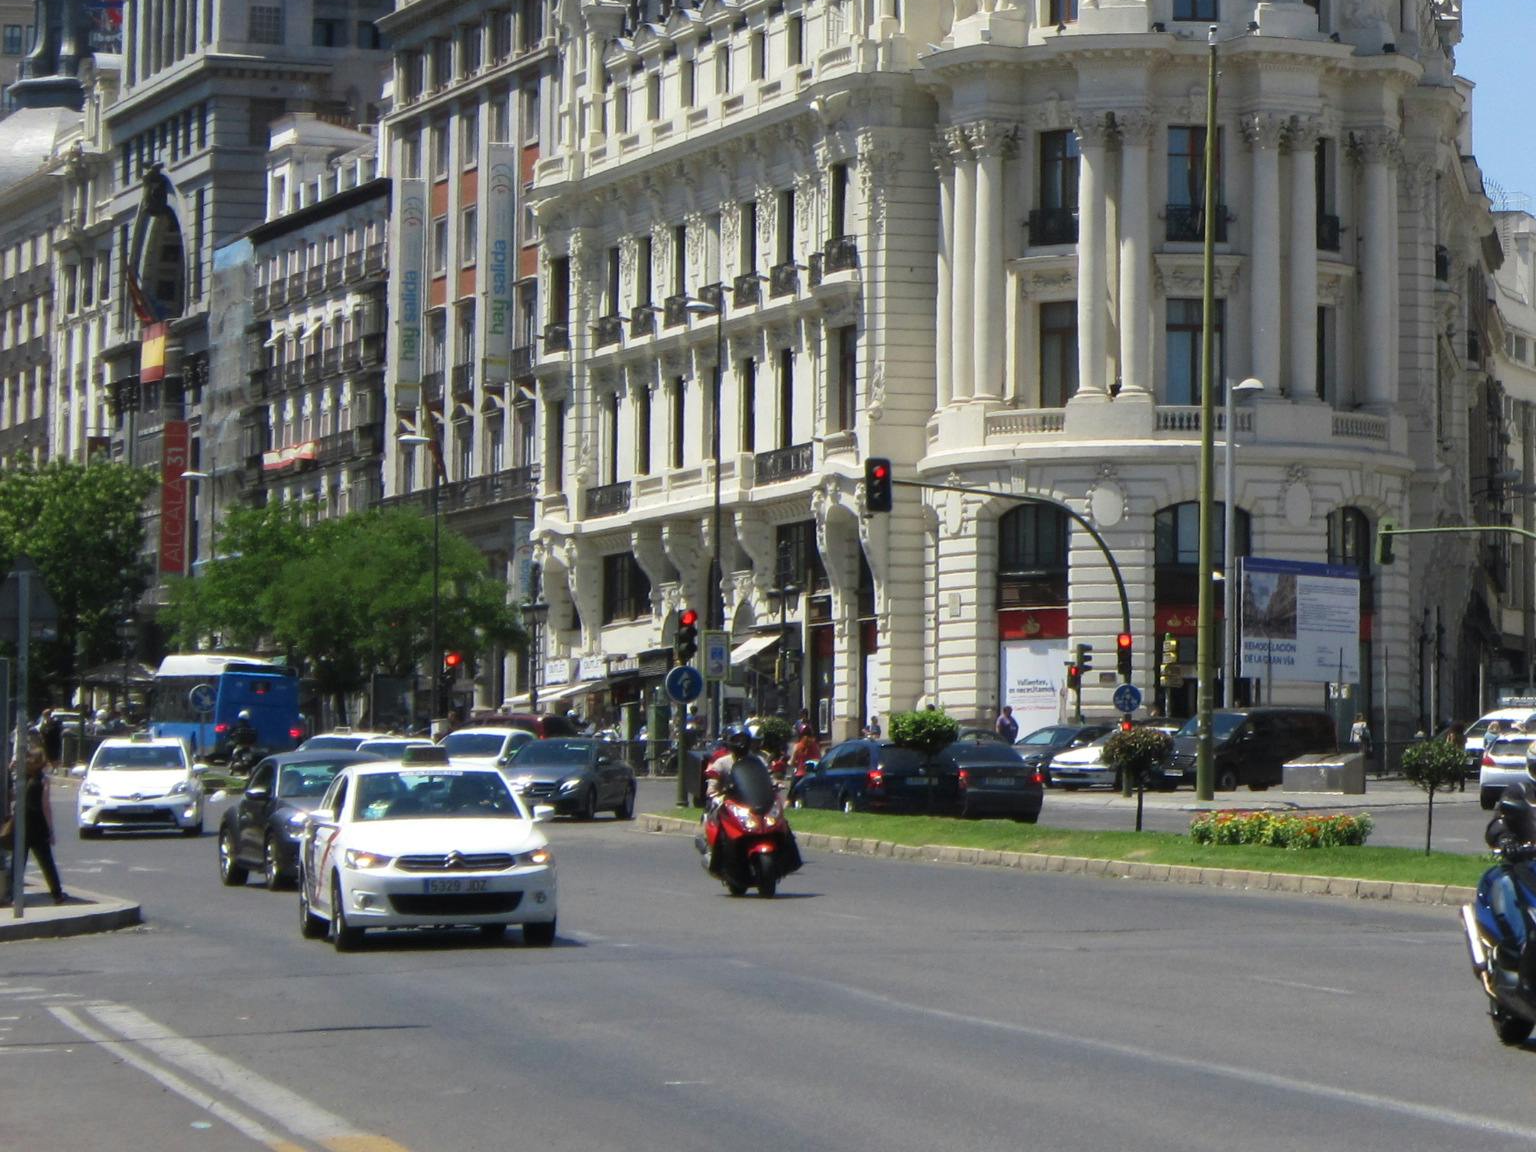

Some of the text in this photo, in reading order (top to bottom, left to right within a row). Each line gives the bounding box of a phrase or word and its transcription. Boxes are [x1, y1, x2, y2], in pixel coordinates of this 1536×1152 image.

[488, 238, 510, 336] hay salida
[400, 269, 420, 362] hay salida
[166, 447, 184, 467] 31
[1244, 640, 1297, 653] REMODLACIÓN
